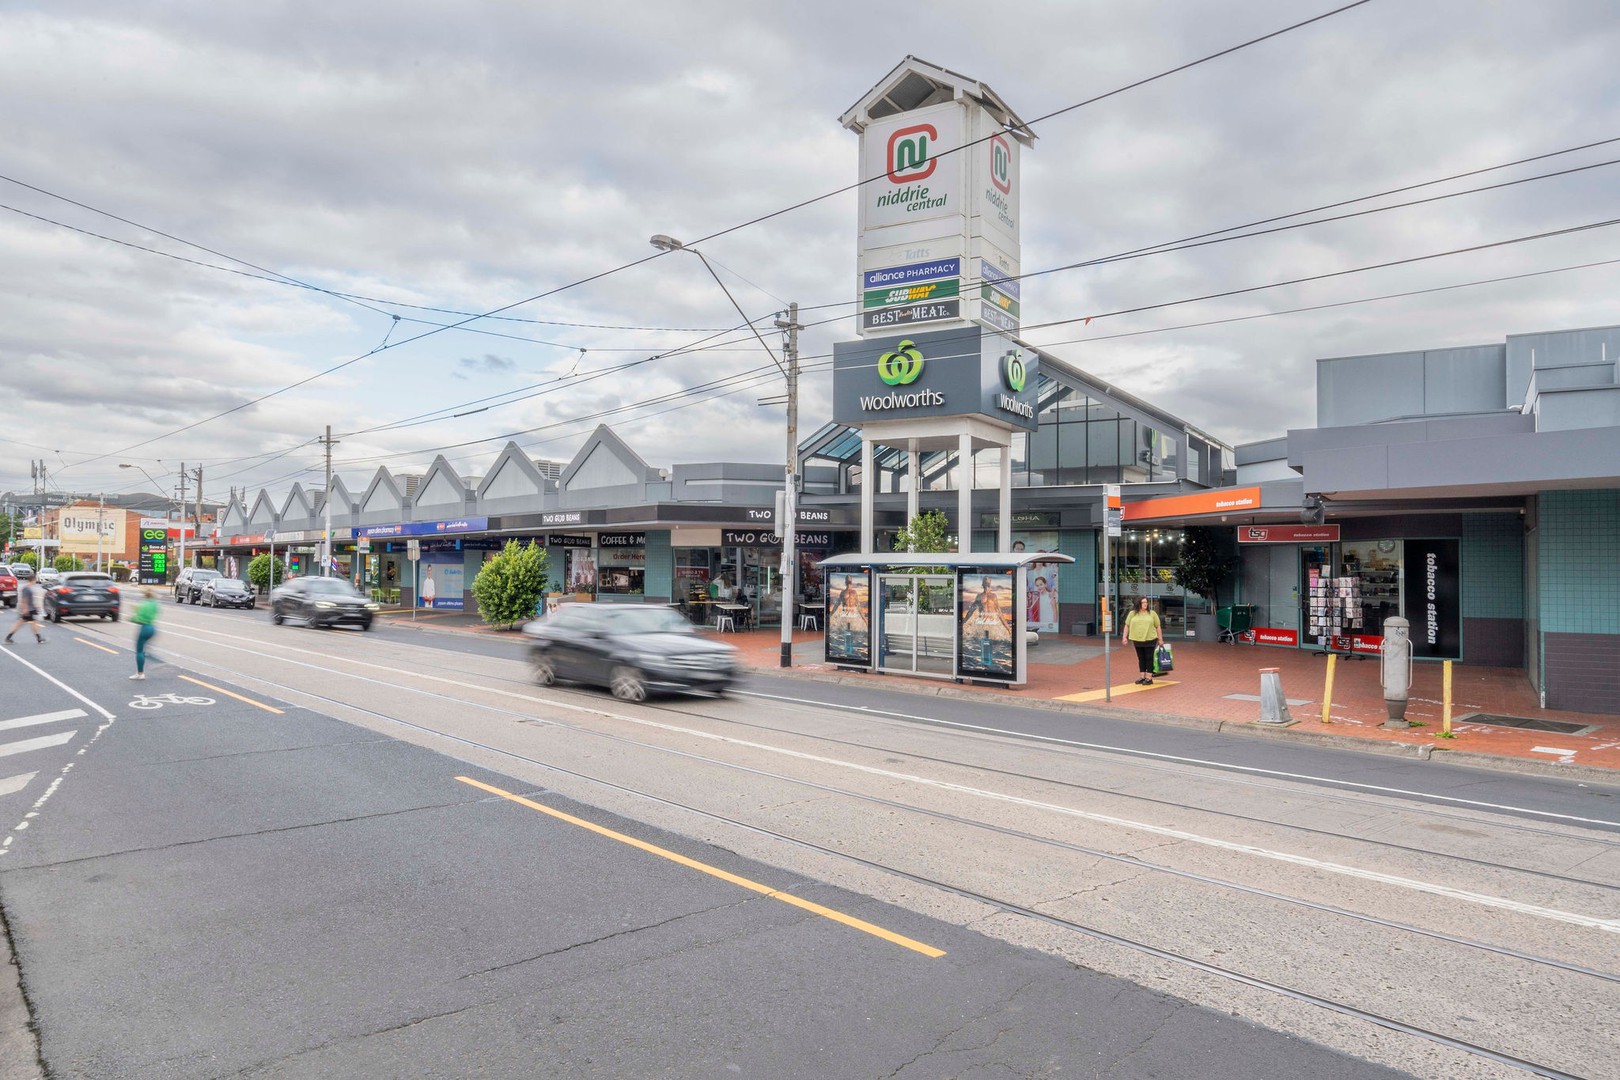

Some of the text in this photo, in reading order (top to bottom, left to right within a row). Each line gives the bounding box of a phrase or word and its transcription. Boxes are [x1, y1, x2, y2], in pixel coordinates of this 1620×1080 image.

[877, 185, 929, 207] niddrie
[906, 193, 948, 212] central
[985, 188, 1008, 214] niddrie
[998, 210, 1015, 228] central
[905, 248, 931, 260] Tatts
[869, 264, 956, 283] alliance PHARMACY
[885, 284, 937, 303] SUBWAY
[872, 309, 900, 325] BEST
[911, 305, 945, 320] MEAT
[860, 388, 945, 411] Woolworths
[1000, 393, 1034, 419] Woolworths
[1216, 498, 1253, 508] tobacco station
[543, 514, 553, 523] TWO
[749, 510, 772, 519] TWO
[800, 511, 828, 520] BEANS
[600, 535, 627, 545] COFFEE
[726, 532, 755, 543] TWO
[794, 534, 828, 544] BEANS
[1248, 527, 1268, 541] tsg
[1426, 552, 1439, 645] tobacco station
[1277, 634, 1293, 642] station
